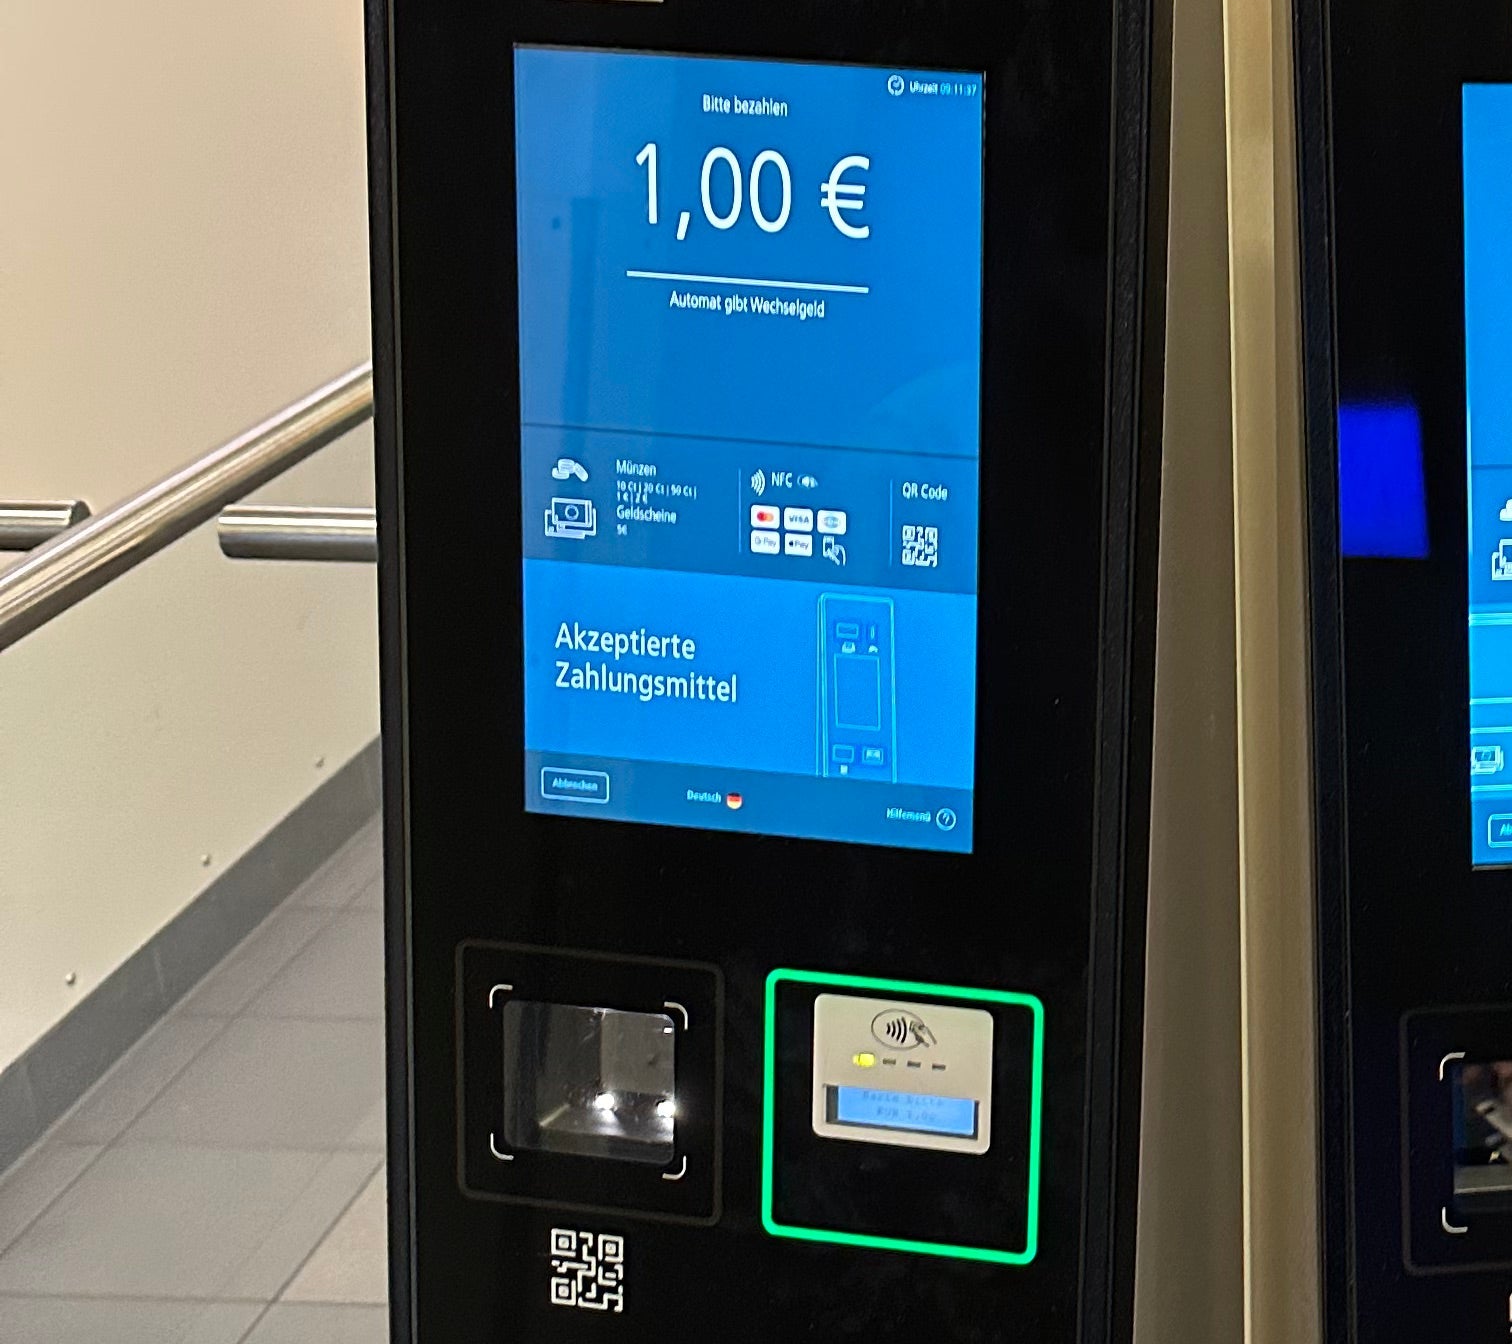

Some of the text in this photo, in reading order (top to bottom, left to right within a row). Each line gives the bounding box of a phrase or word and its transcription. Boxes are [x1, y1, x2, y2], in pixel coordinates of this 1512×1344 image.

[703, 94, 788, 117] Bitte bezahlen
[635, 142, 870, 241] 1,00 €
[670, 290, 824, 320] Automat gibt Wechselgeld
[616, 459, 656, 476] Münzen
[771, 472, 792, 488] NFC
[902, 482, 948, 500] QR Code
[616, 504, 676, 524] Geldscheine
[554, 622, 696, 660] Akzeptierte
[555, 661, 737, 702] Zahlungsmittel
[687, 790, 721, 803] Deutsch
